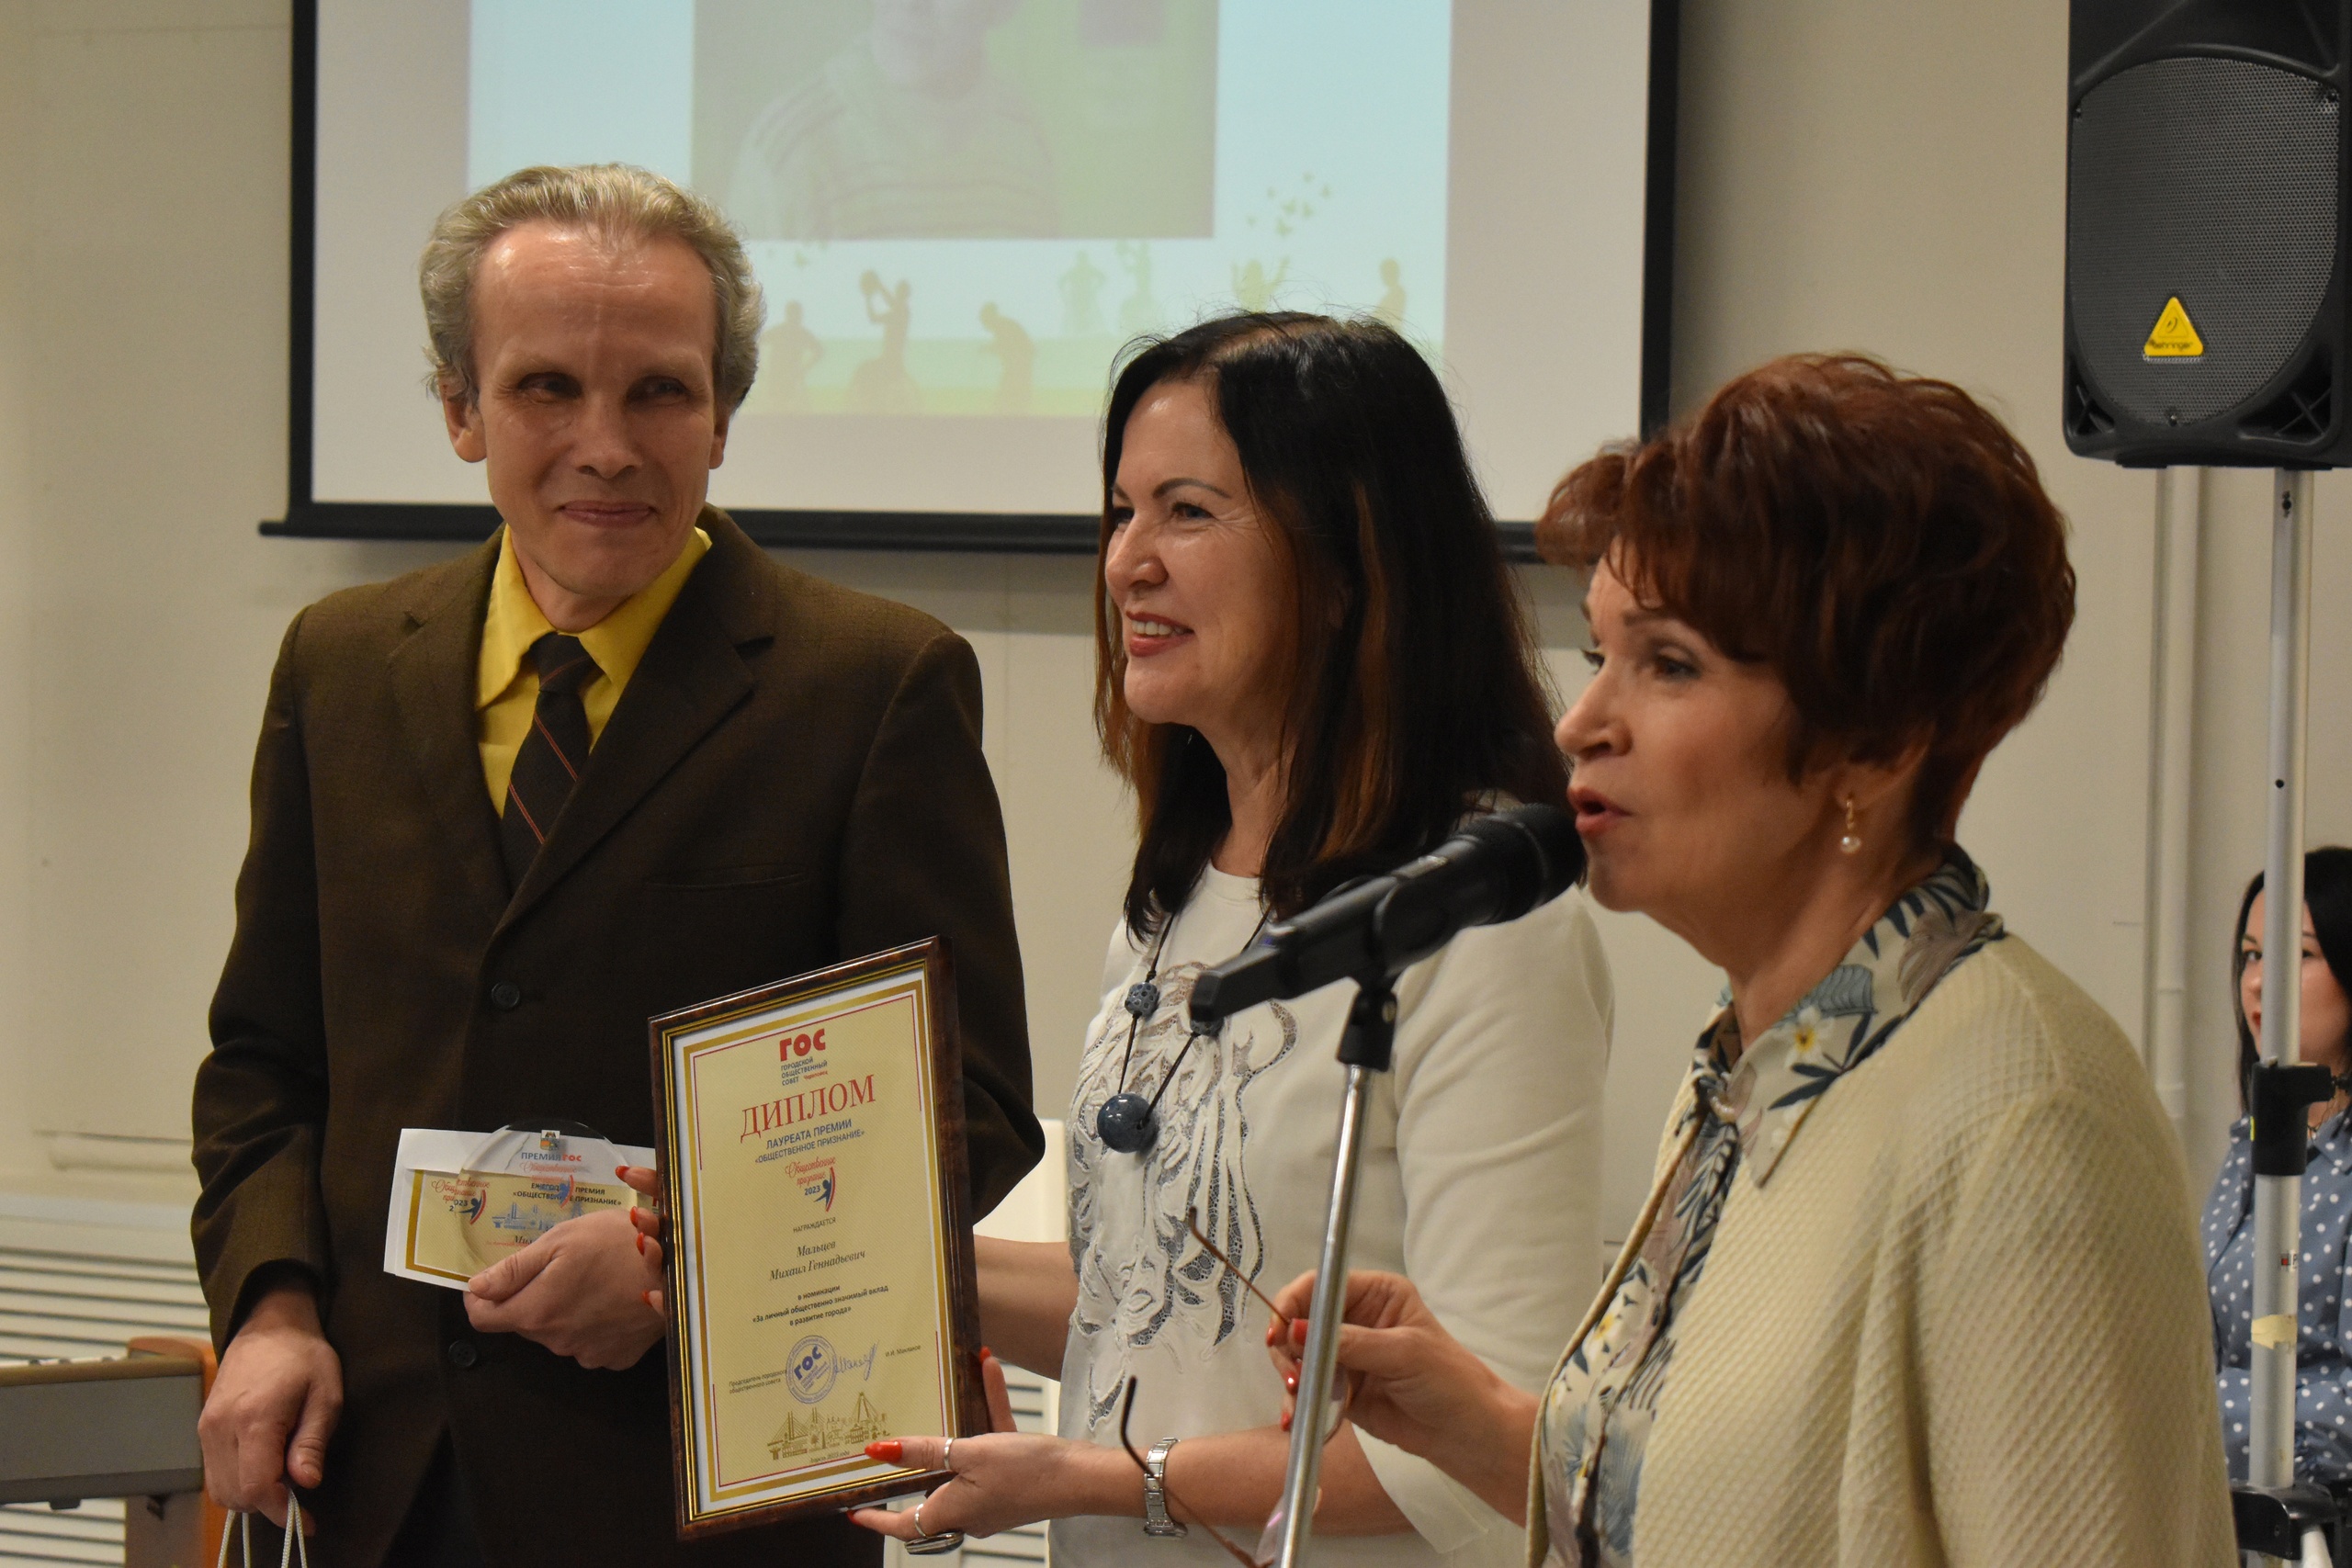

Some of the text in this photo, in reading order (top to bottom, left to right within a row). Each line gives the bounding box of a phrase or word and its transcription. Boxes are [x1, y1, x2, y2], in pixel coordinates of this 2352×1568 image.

[779, 1028, 826, 1062] ГОС
[781, 1056, 814, 1071] ГОРОДСКОЙ
[781, 1059, 828, 1079] ОБЩЕСТВЕННЫЙ
[782, 1077, 799, 1086] СОВЕТ
[740, 1074, 876, 1144] ДИПЛОМ
[766, 1119, 853, 1149] ЛАУРЕАТА ПРЕМИИ
[754, 1129, 865, 1164] «ОБЩЕСТВЕННОЕ ПРИЗНАНИЕ»
[574, 1186, 605, 1195] ПРЕМИЯ
[804, 1184, 821, 1196] 2023
[574, 1195, 622, 1206] ПРИЗНАНИЕ»
[793, 1217, 837, 1233] НАГРАЖДАЕТСЯ
[797, 1241, 836, 1258] Мальцев
[769, 1249, 866, 1281] Михаил Геннадьевич
[803, 1285, 841, 1300] номинации
[752, 1284, 889, 1324] «За личный общественно значимый вклад
[795, 1312, 824, 1326] развитие
[824, 1306, 852, 1319] города»
